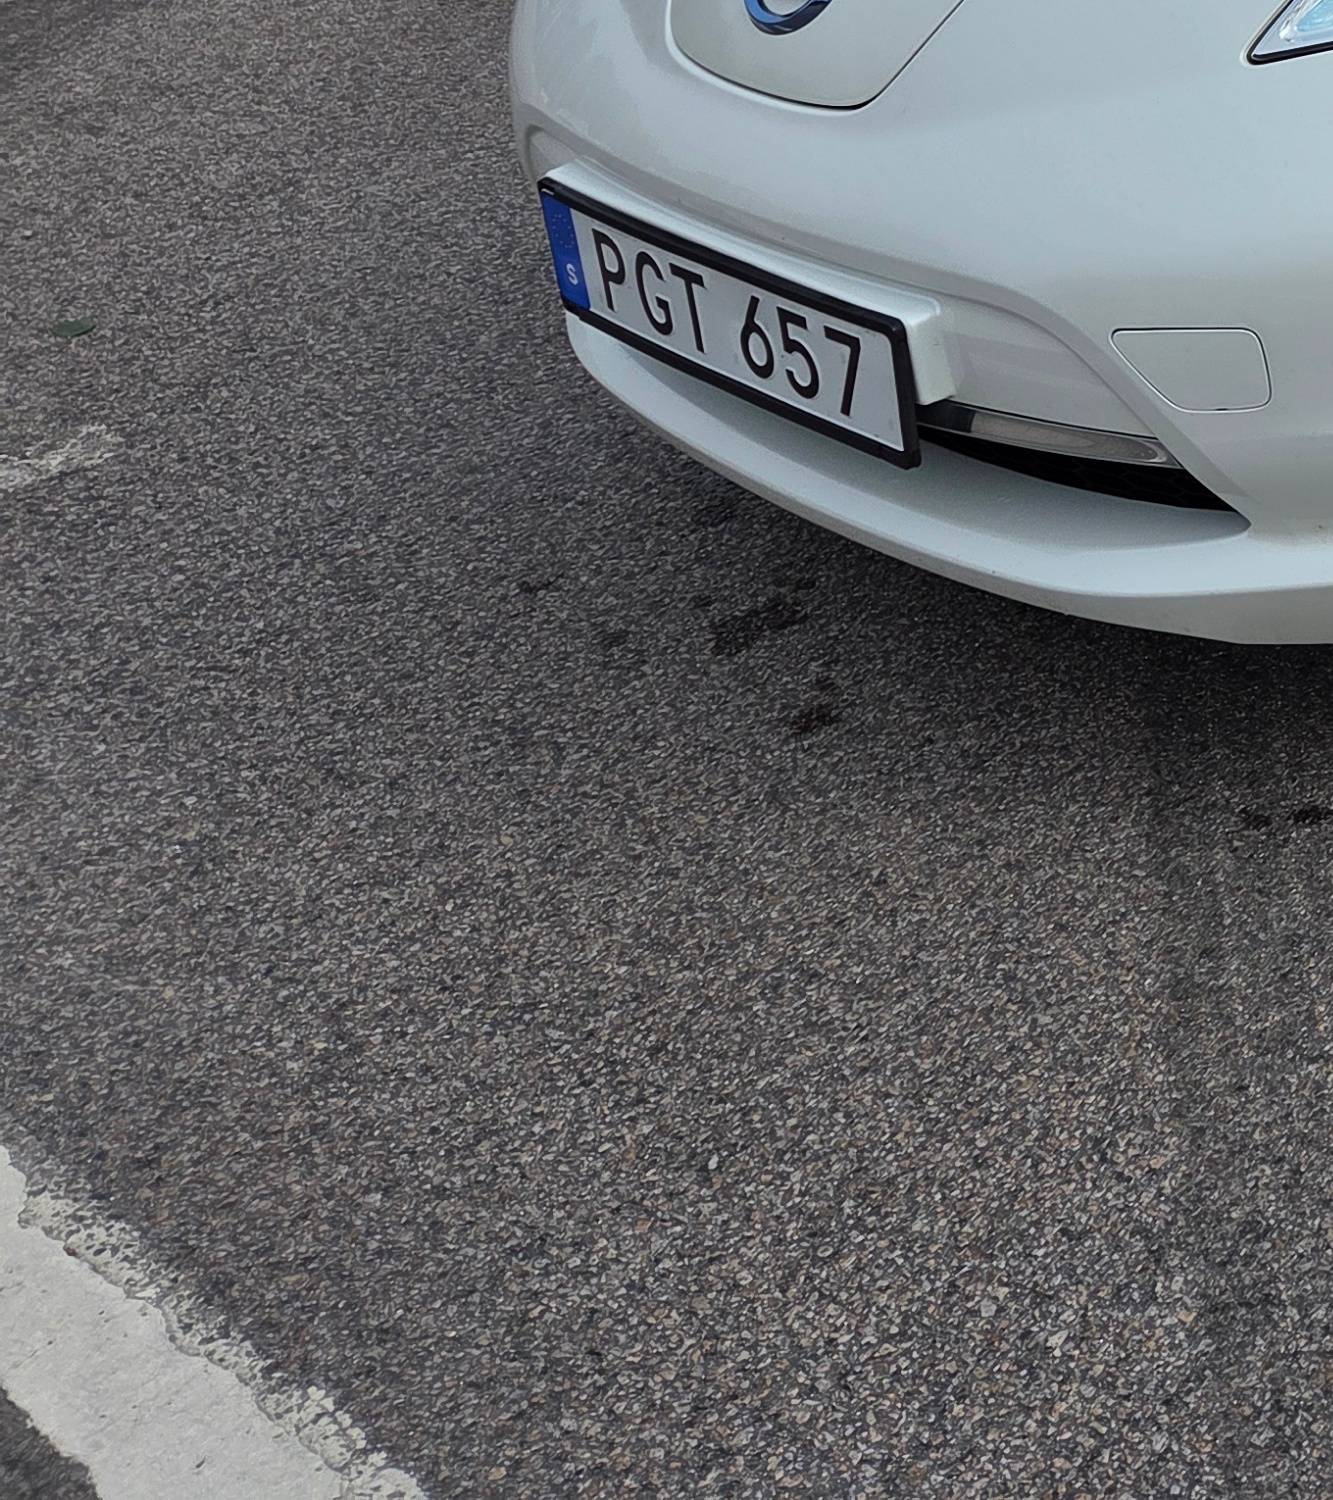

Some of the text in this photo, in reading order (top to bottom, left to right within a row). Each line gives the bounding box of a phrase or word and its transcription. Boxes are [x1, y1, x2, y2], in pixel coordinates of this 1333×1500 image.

[566, 262, 579, 285] S
[591, 227, 861, 418] PGT 657
